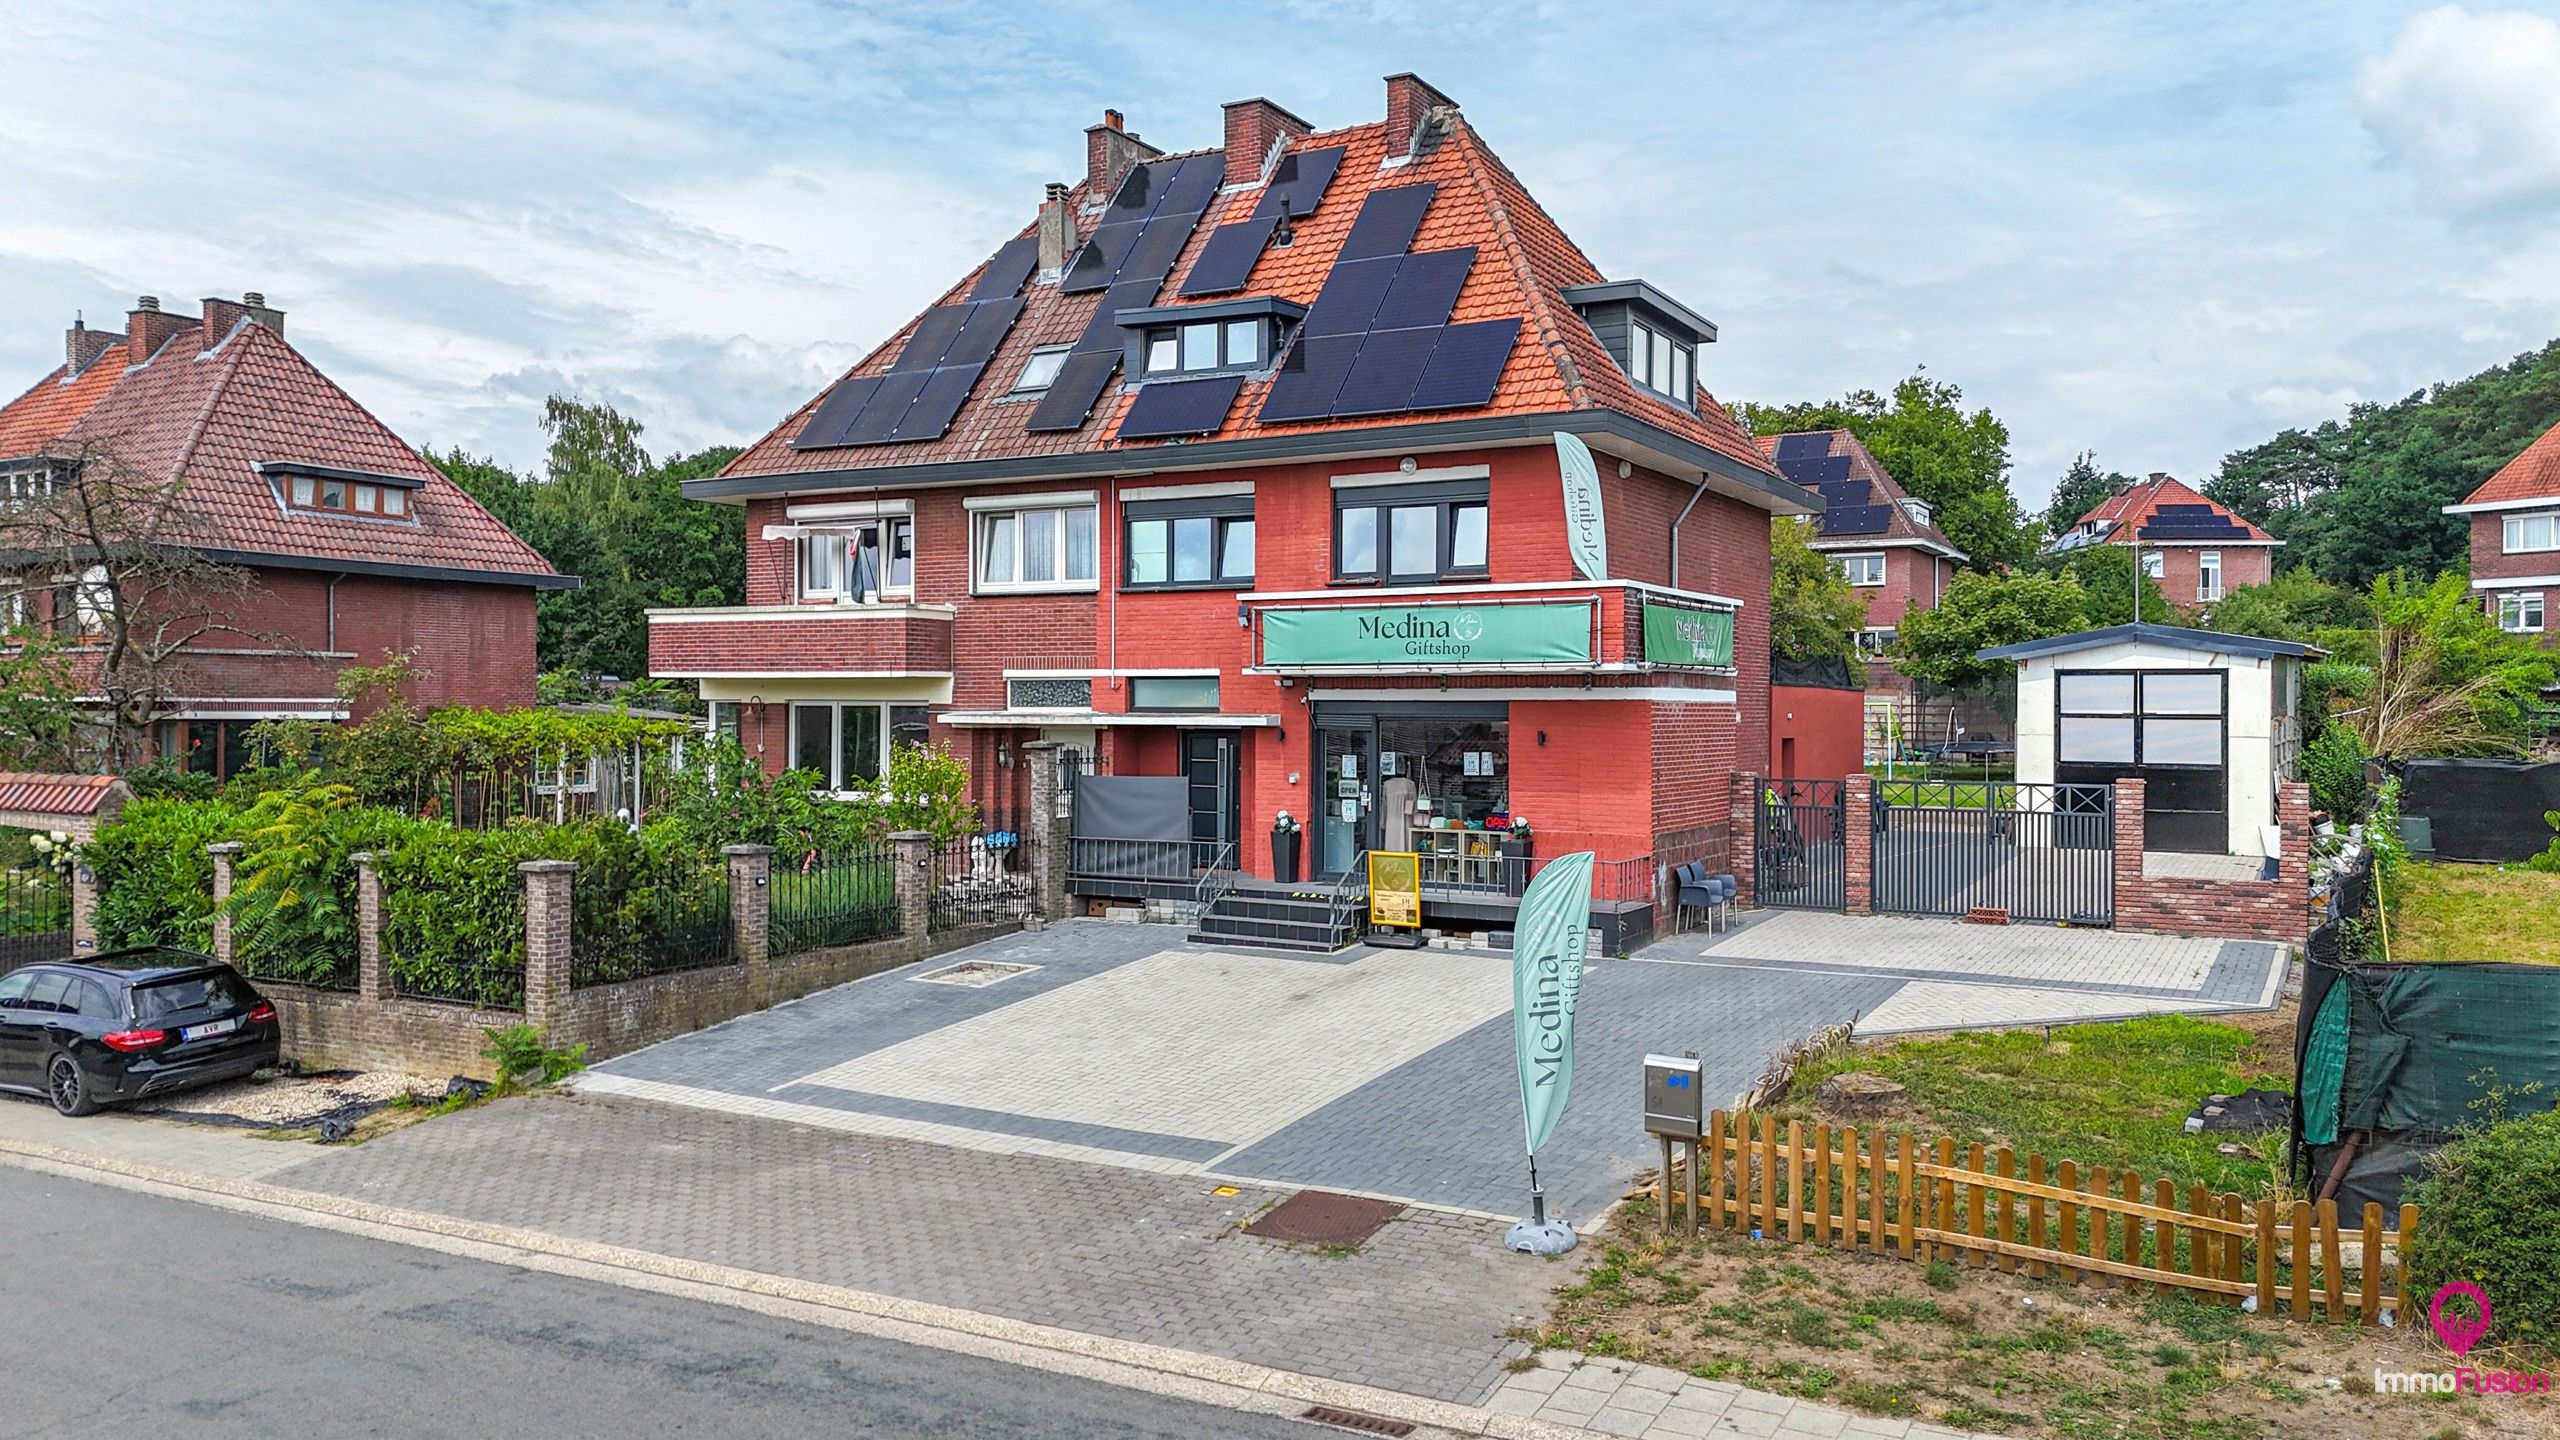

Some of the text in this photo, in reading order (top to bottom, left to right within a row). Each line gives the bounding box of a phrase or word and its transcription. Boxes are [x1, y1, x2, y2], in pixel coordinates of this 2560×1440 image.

[1358, 612, 1450, 639] Medina
[1405, 640, 1471, 659] Giftshop
[1561, 924, 1584, 1016] Giftshop
[1528, 953, 1563, 1088] Medina
